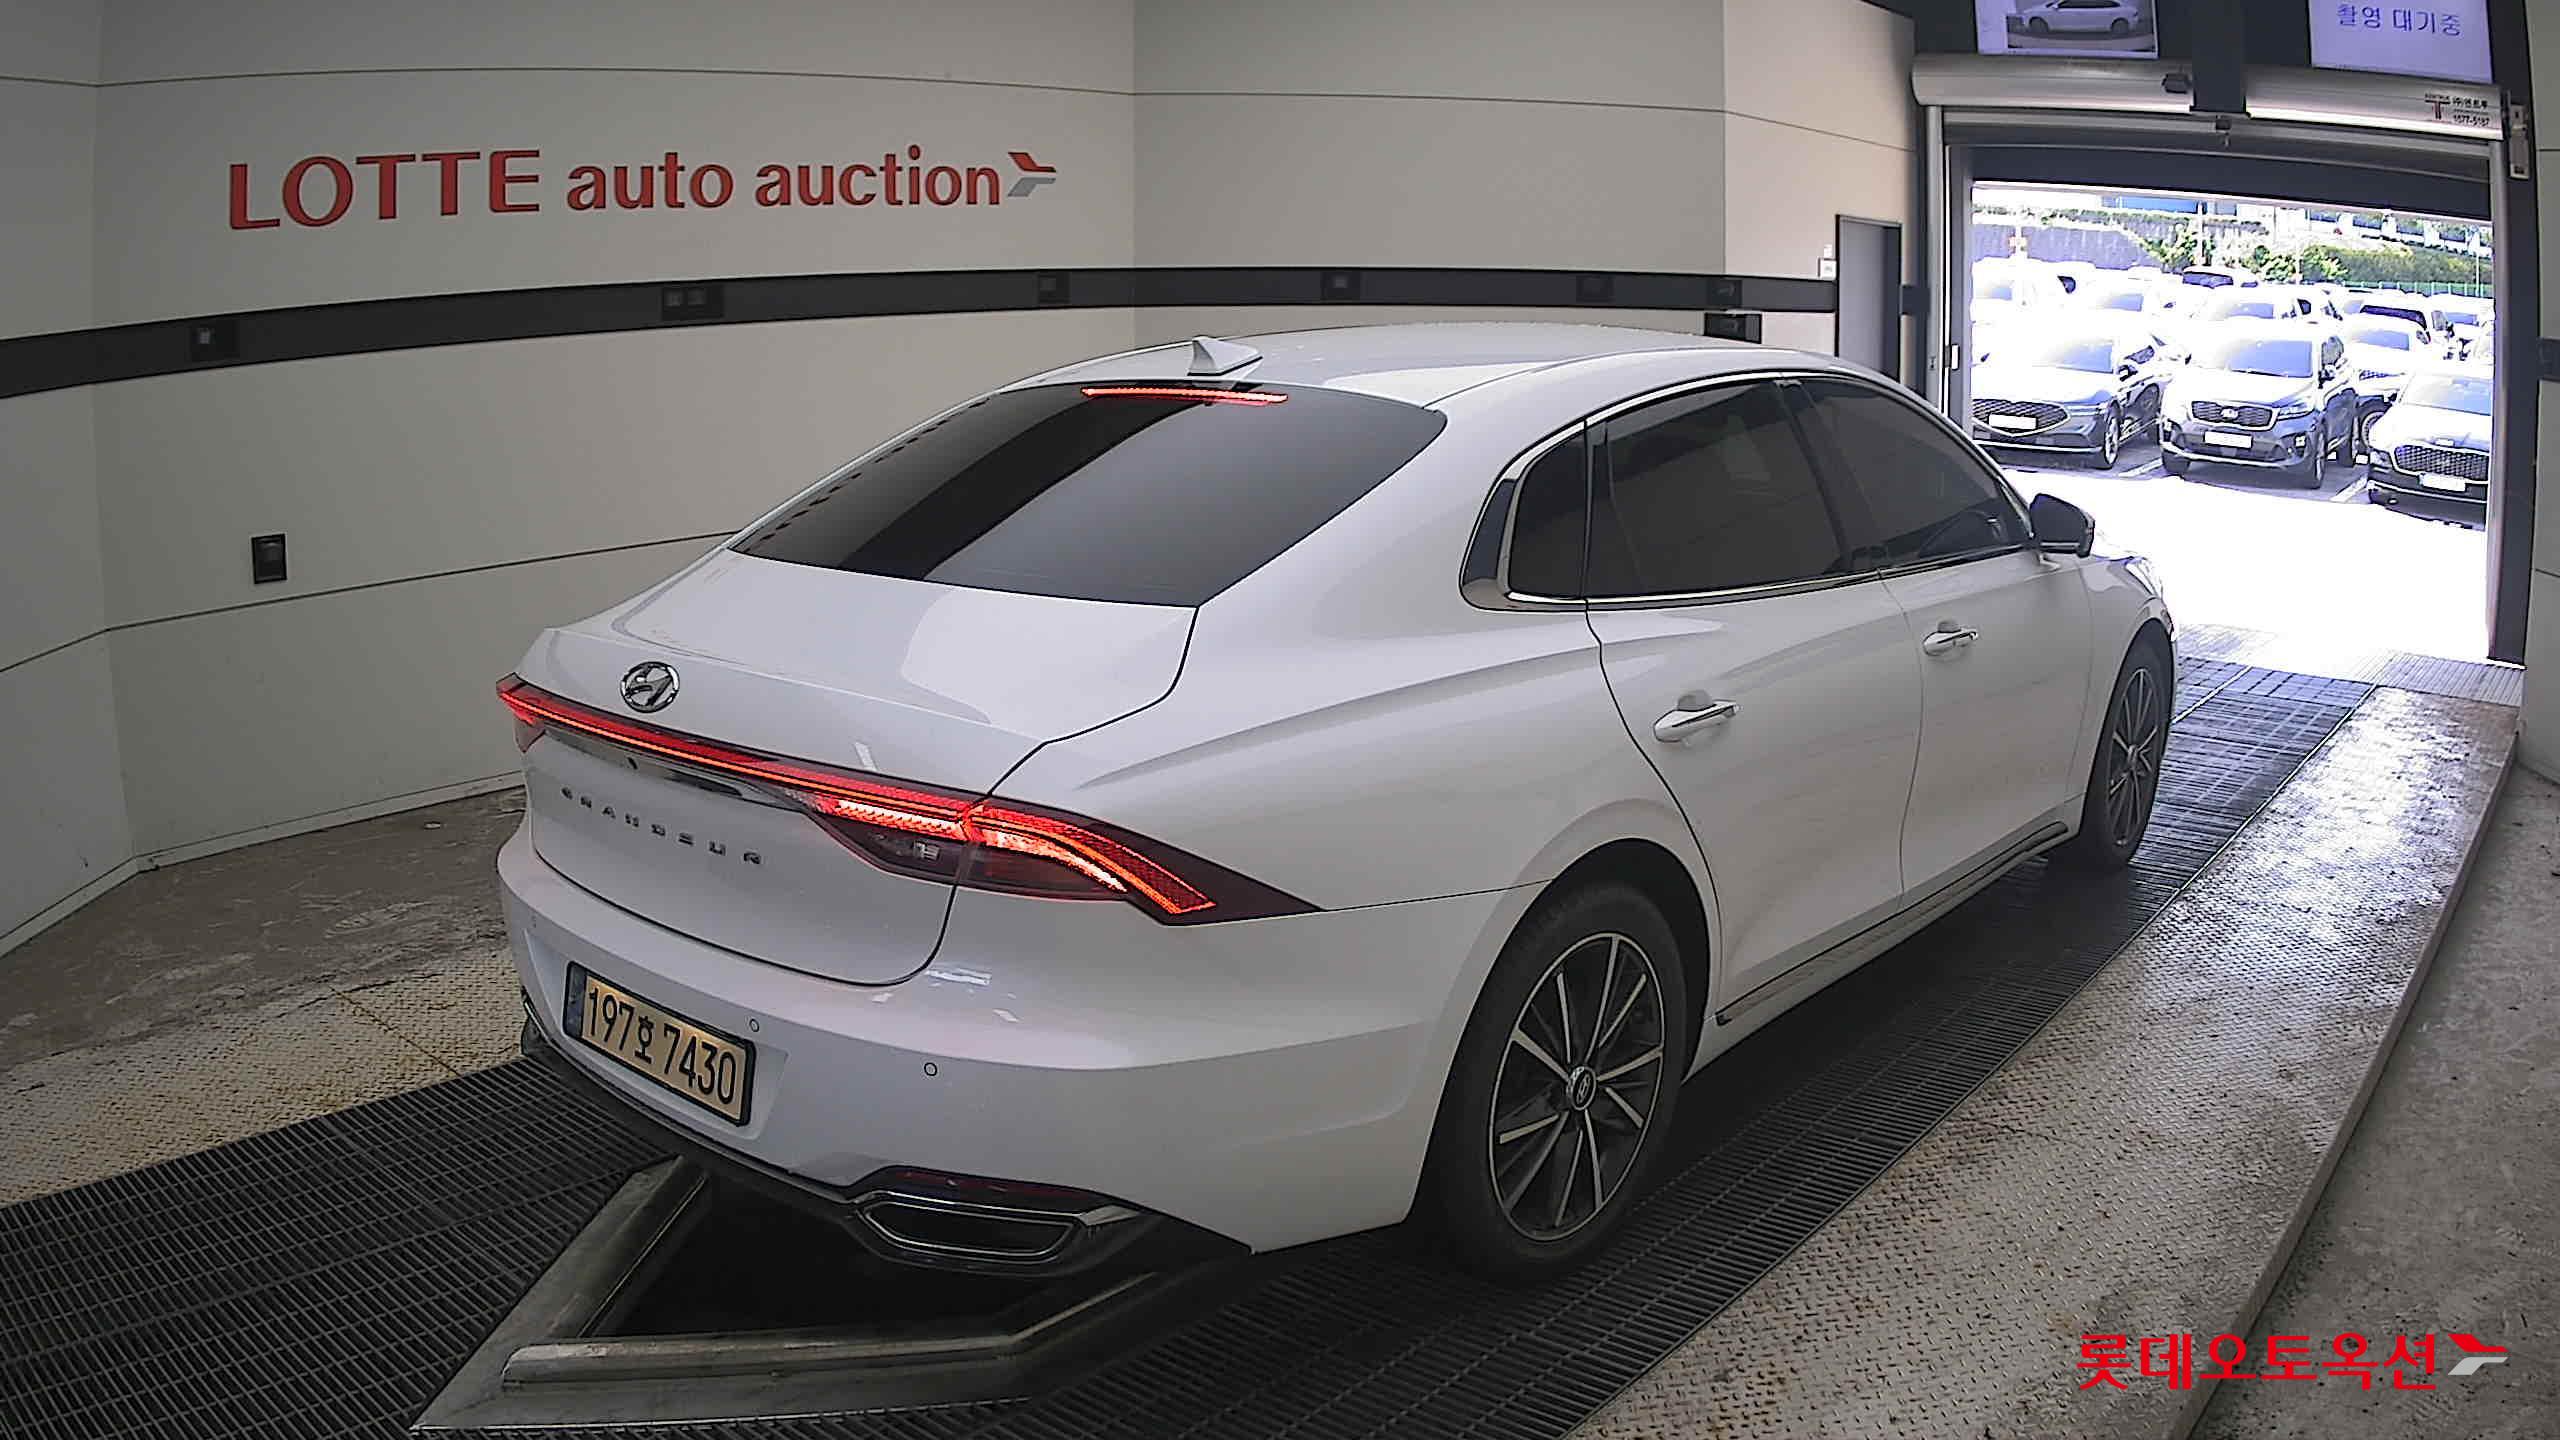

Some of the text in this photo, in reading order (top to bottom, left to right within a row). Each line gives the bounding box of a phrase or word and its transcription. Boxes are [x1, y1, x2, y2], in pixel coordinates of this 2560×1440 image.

[2338, 4, 2461, 37] 촬영 대기중
[229, 146, 1001, 230] LOTTE auto auction
[560, 786, 762, 865] GRANDEUR
[589, 987, 736, 1104] 197호 7430
